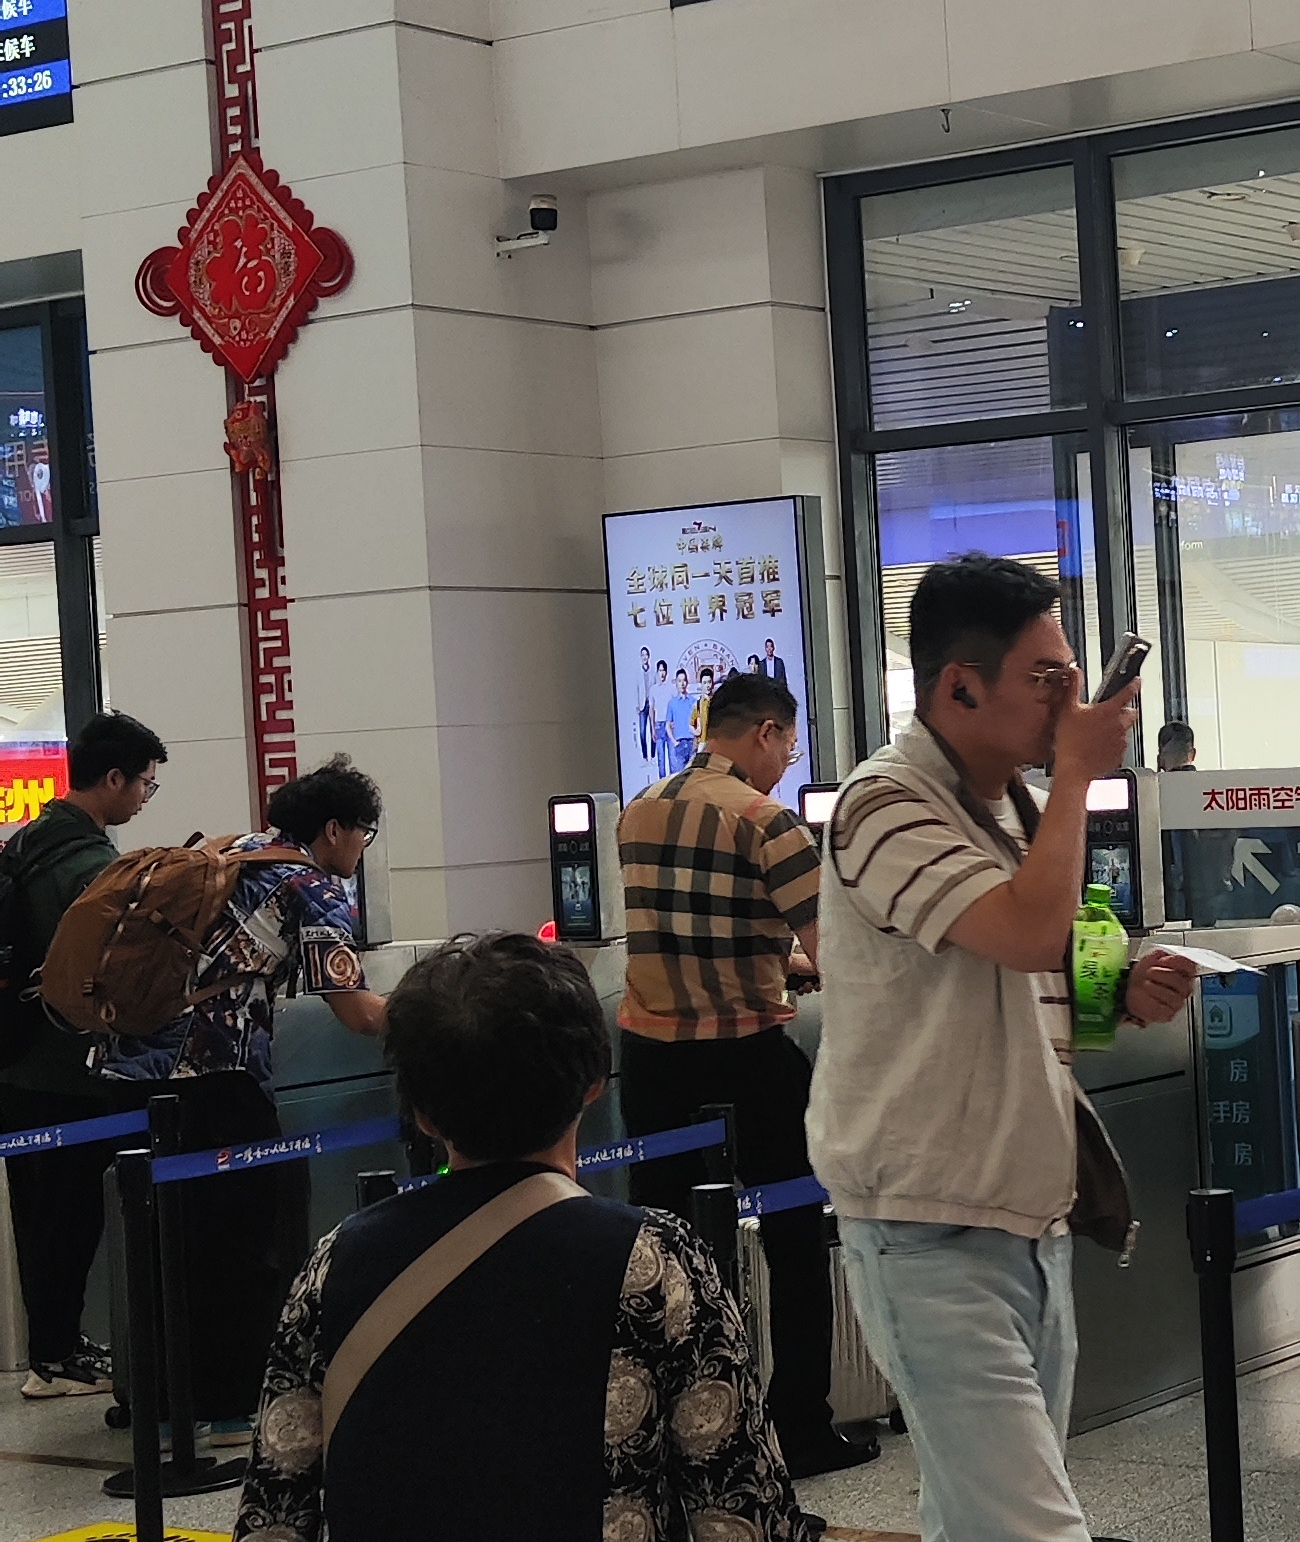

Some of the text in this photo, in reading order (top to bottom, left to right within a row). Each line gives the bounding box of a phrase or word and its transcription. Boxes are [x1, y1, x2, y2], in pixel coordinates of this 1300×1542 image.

[206, 211, 280, 312] 福
[1181, 540, 1204, 551] form
[626, 555, 781, 595] 全球同一天首推
[627, 589, 783, 628] 七位世界冠军
[0, 778, 54, 822] 州
[1209, 1100, 1250, 1124] 手房
